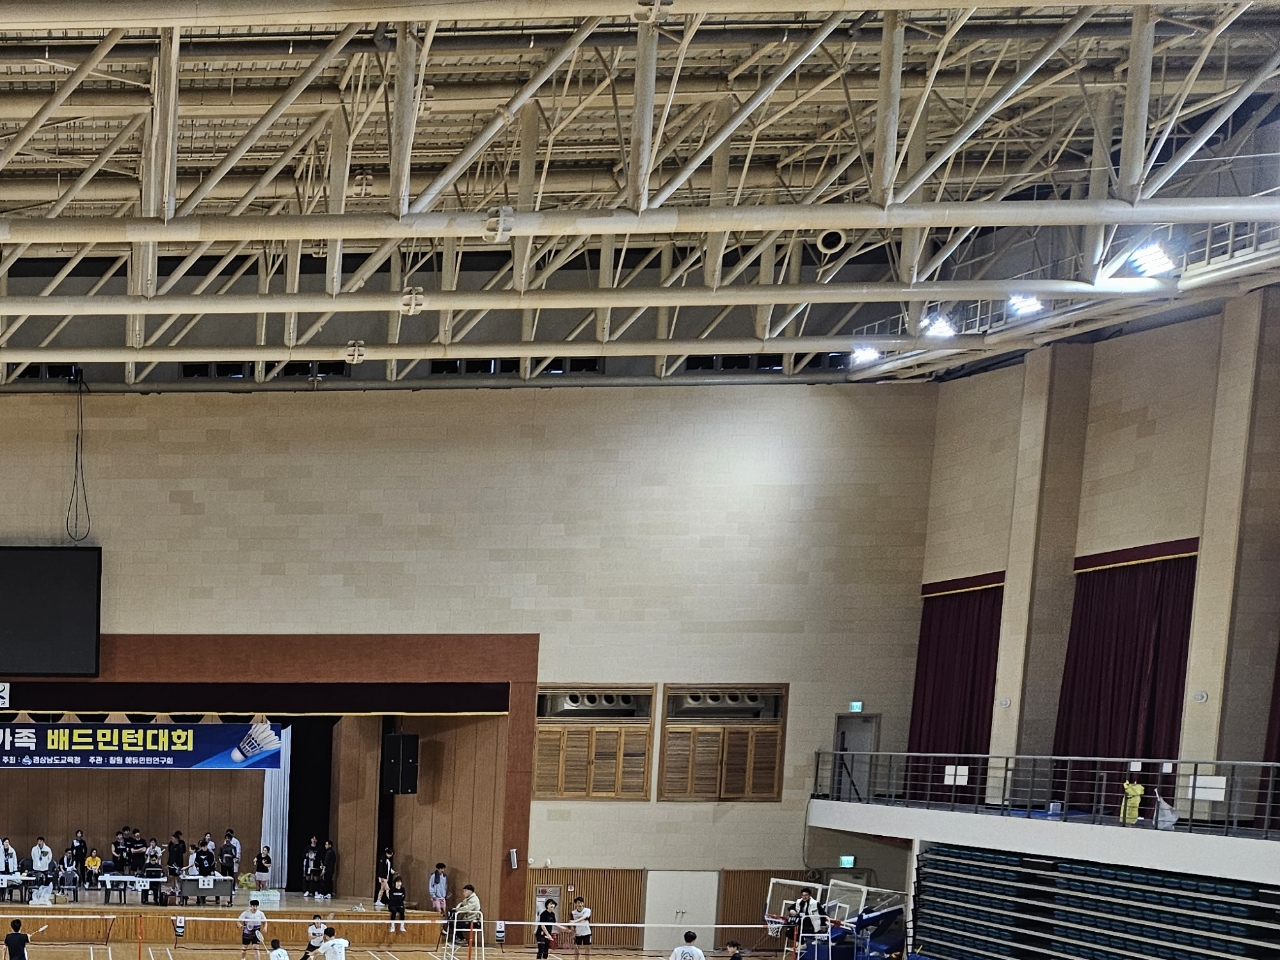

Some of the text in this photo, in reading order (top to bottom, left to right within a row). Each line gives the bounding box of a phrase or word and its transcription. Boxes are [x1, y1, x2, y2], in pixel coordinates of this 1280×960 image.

[47, 729, 194, 751] 배드민턴대회
[2, 756, 16, 764] 주최
[33, 756, 81, 764] 경상남도교육청
